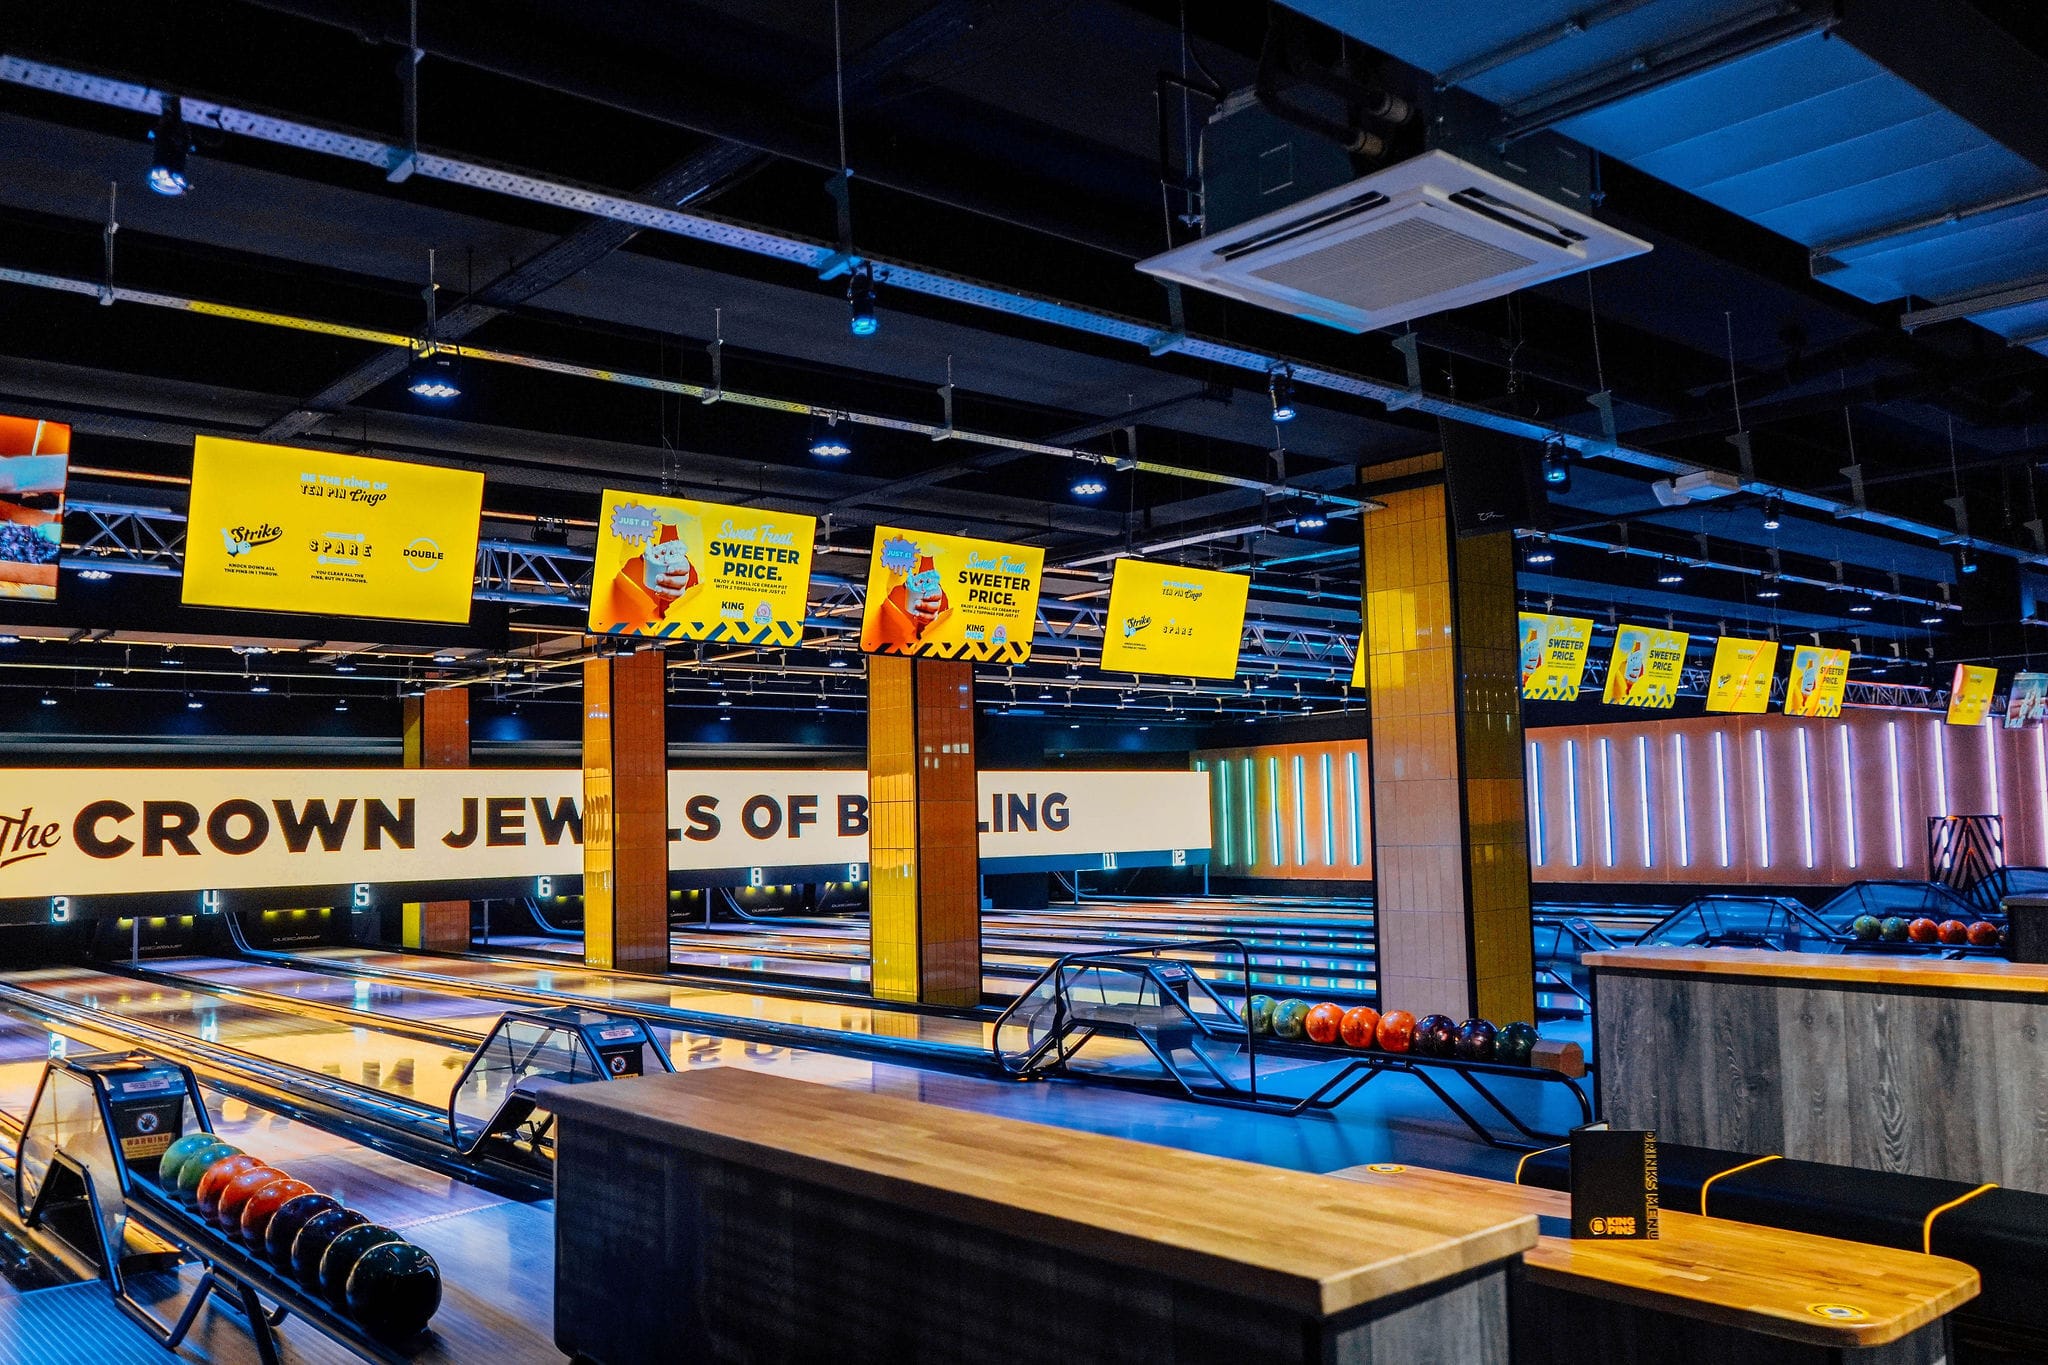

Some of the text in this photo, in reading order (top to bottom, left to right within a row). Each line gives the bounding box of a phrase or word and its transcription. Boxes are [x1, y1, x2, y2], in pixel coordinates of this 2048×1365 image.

[319, 475, 340, 486] THE
[343, 476, 371, 489] KING
[301, 485, 386, 506] TEN PIN Lingo
[619, 517, 639, 525] JUST
[717, 519, 757, 540] Sweet
[231, 524, 282, 543] Strike
[310, 540, 372, 557] SPARE
[404, 550, 444, 559] DOUBLE
[709, 542, 800, 564] SWEETER
[723, 562, 782, 581] PRICE.
[958, 571, 1030, 591] SWEETER
[722, 601, 744, 610] KING
[969, 589, 1016, 606] PRICE.
[967, 624, 984, 632] KING
[1548, 639, 1584, 650] SWEETER
[1650, 650, 1680, 661] SWEETER
[0, 792, 1069, 859] The CROWN JEWS OF BING
[1104, 852, 1117, 870] 11
[1173, 849, 1185, 866] 12
[752, 867, 762, 887] 8
[850, 863, 860, 882] 9
[355, 884, 369, 906] 5
[538, 876, 551, 898] 6
[53, 896, 69, 922] 3
[203, 890, 219, 914] 4
[127, 1135, 169, 1145] WARNING
[1645, 1132, 1659, 1240] DRINKS MENU
[1607, 1217, 1636, 1225] KING
[1607, 1226, 1636, 1235] PINS
